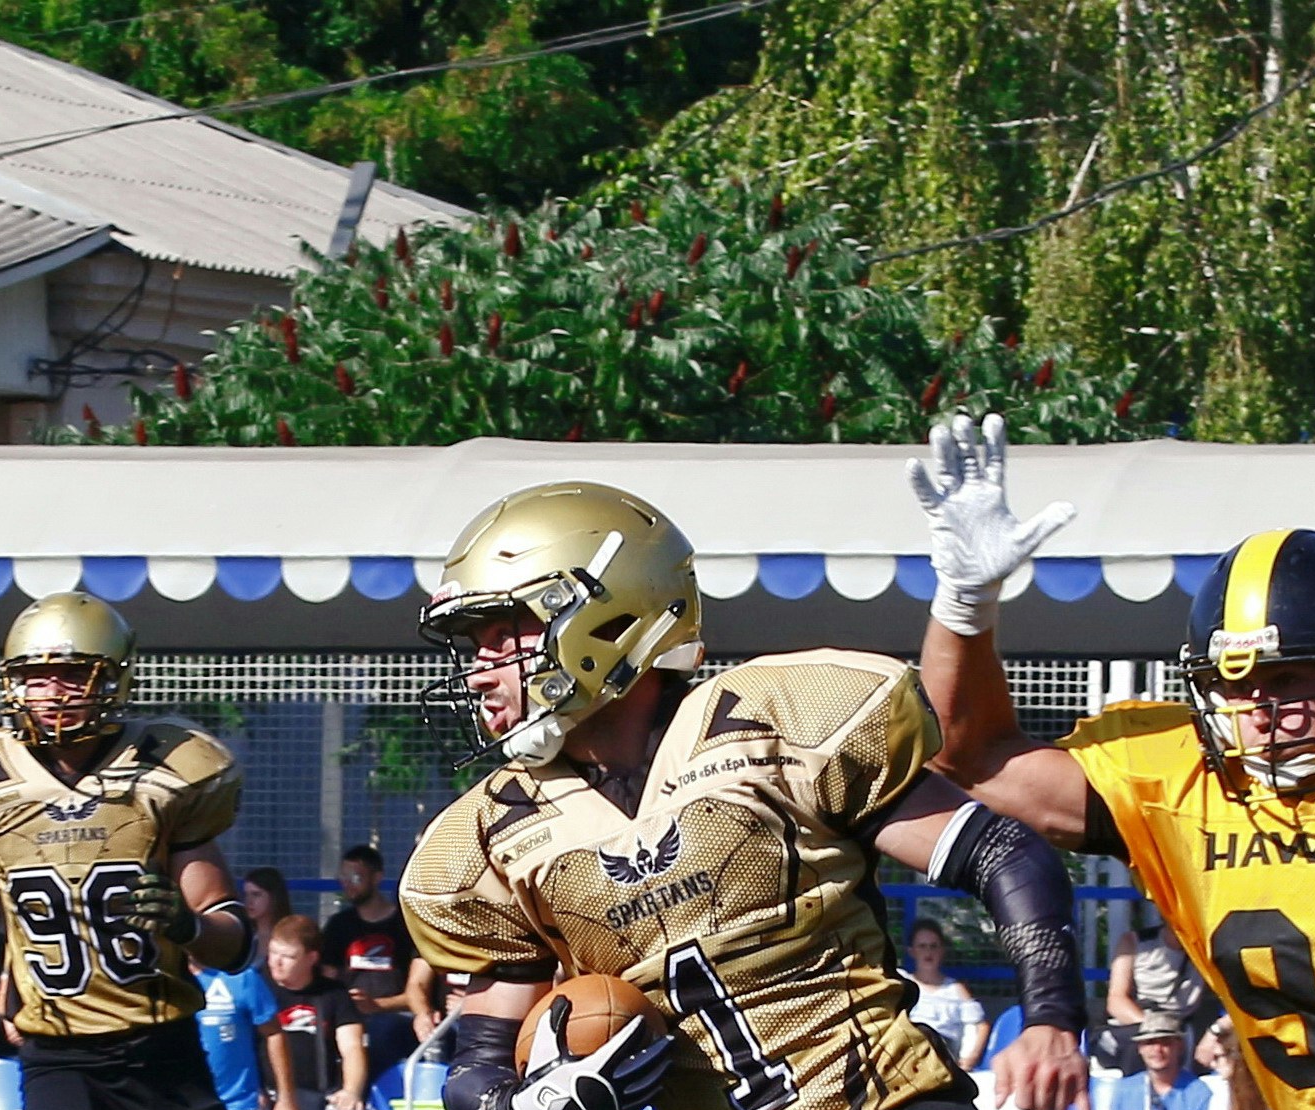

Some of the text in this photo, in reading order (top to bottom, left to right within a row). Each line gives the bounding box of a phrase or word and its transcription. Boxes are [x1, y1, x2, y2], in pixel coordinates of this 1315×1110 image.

[35, 827, 108, 845] SPARTANS
[8, 861, 162, 997] 96
[606, 869, 715, 931] SPARTANS
